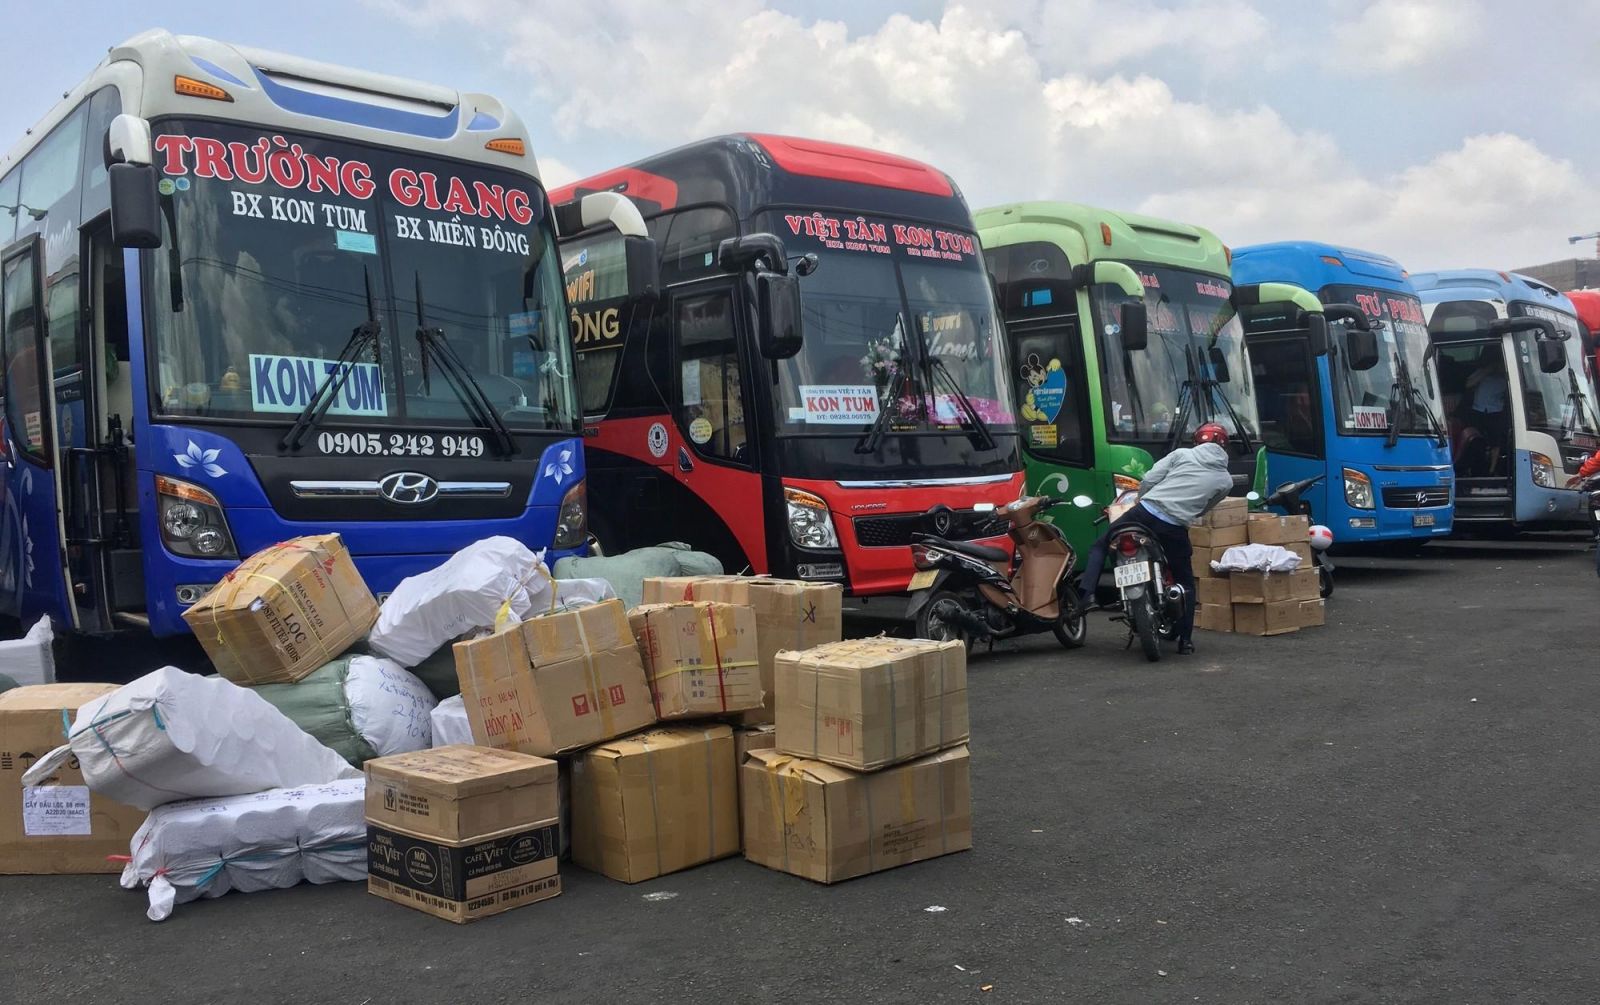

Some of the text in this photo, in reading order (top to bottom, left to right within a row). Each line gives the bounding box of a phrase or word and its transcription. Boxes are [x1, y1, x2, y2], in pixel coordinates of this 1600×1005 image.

[155, 134, 533, 225] TRƯỜNG GIANG
[231, 191, 368, 233] BX KON TUM
[395, 214, 530, 256] BX MIỀN ĐÔNG
[785, 212, 975, 255] VIỆT TÂN KON TUM
[254, 357, 383, 411] KON TUM
[806, 396, 876, 412] KON TUM
[1355, 412, 1387, 428] KON TUM
[317, 432, 484, 457] 0905.242 949
